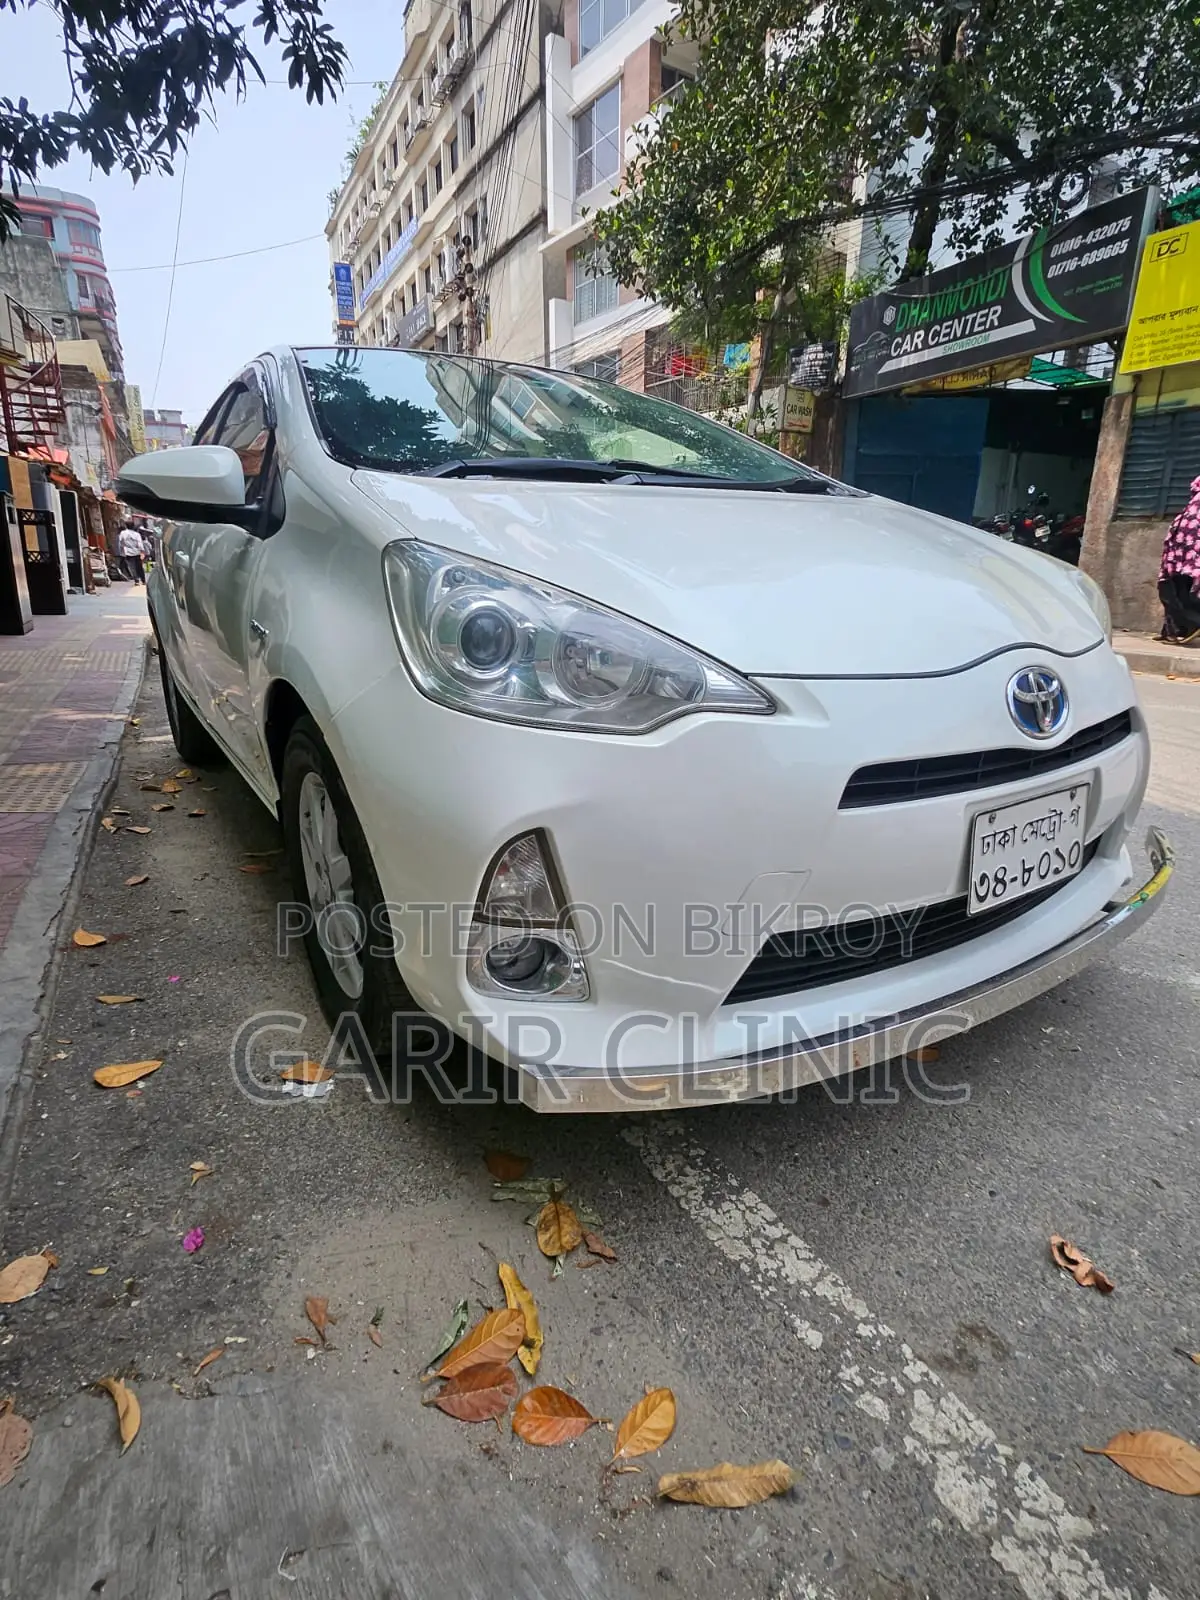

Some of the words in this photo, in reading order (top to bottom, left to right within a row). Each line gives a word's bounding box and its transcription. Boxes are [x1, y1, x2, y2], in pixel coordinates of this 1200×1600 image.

[1050, 216, 1132, 258] 01816-432075
[1157, 238, 1180, 258] DC
[1047, 238, 1130, 278] 01716-689665
[895, 267, 1011, 333] DHANMONDI
[337, 330, 354, 340] FIT
[890, 330, 925, 357] CAR
[928, 305, 1002, 345] CENTER
[942, 333, 990, 354] SHOWROOM
[786, 404, 798, 414] CAR
[798, 406, 813, 417] WASH
[981, 823, 1018, 855] ঢাকা
[974, 840, 1081, 903] ৩৪-৮০১০
